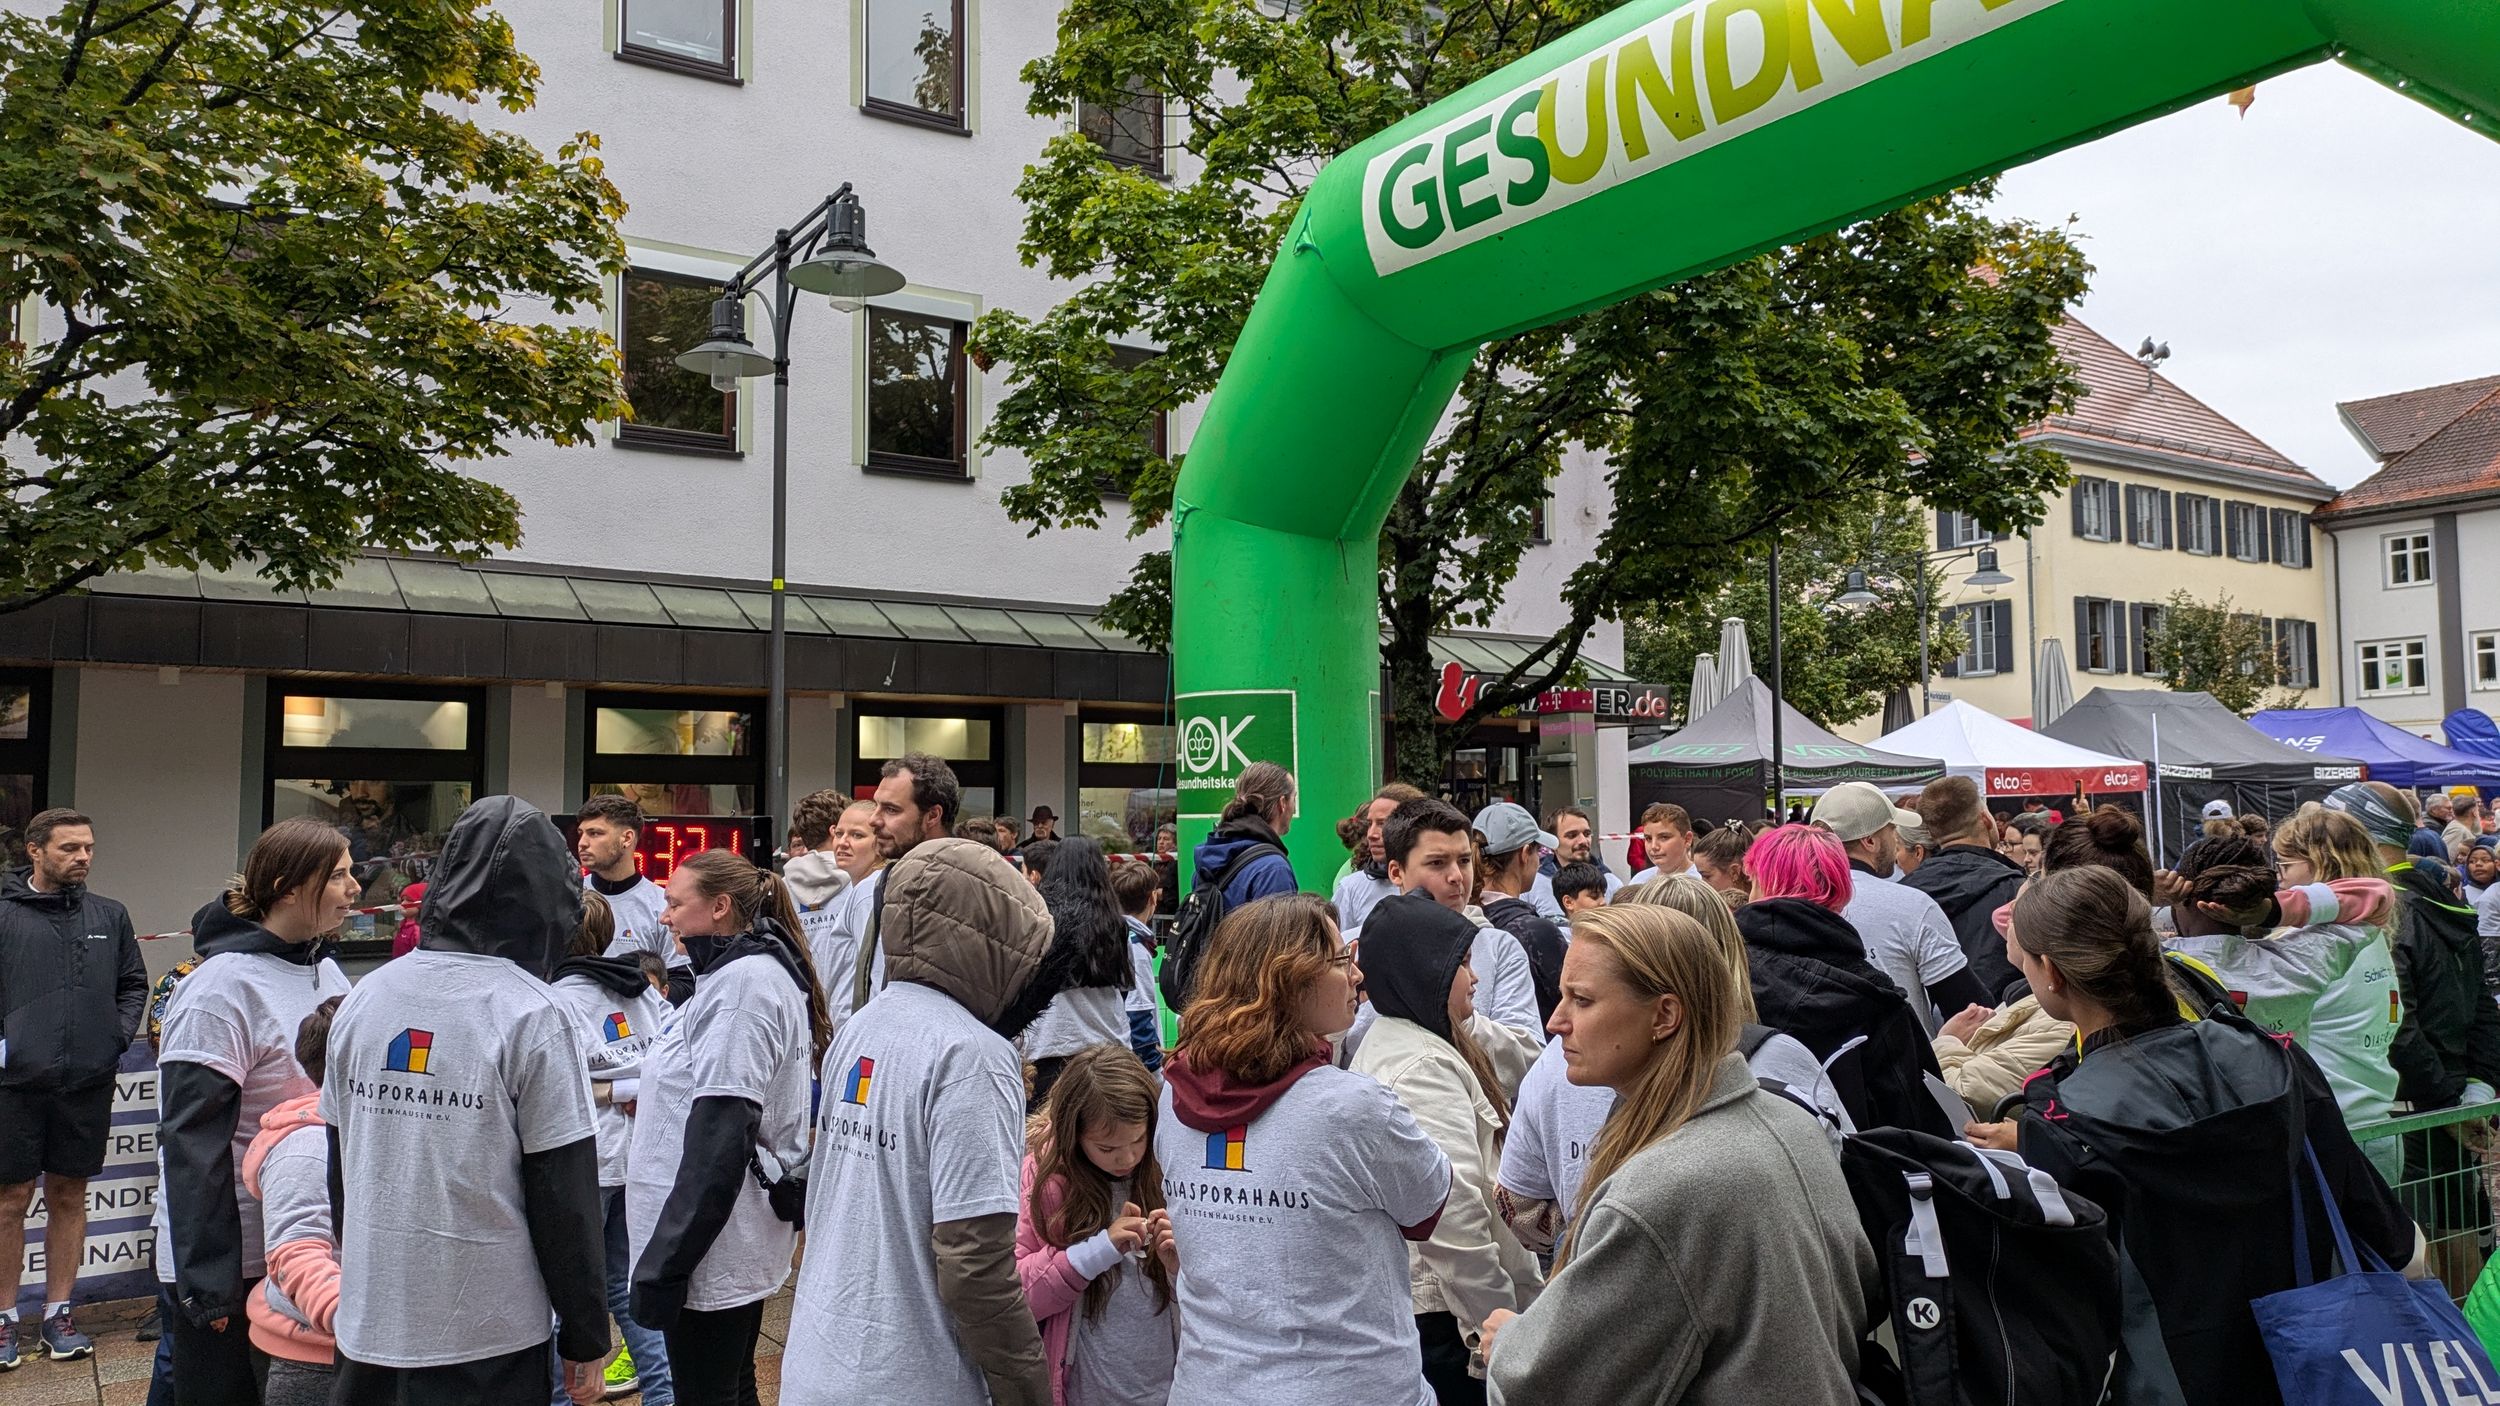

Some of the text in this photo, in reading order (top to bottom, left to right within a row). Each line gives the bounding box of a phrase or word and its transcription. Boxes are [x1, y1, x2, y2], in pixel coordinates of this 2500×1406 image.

[1640, 767, 1709, 779] POLYURETHAN
[1711, 767, 1722, 777] IN
[1725, 767, 1755, 777] FORM
[1837, 767, 1900, 779] POLYURETHAN
[2104, 771, 2128, 787] elco
[1993, 773, 2020, 790] elco
[1164, 1178, 1310, 1209] DIASPORAHAUS
[1184, 1207, 1255, 1223] BIETENHAUSEN
[2340, 1339, 2500, 1406] VIEL
